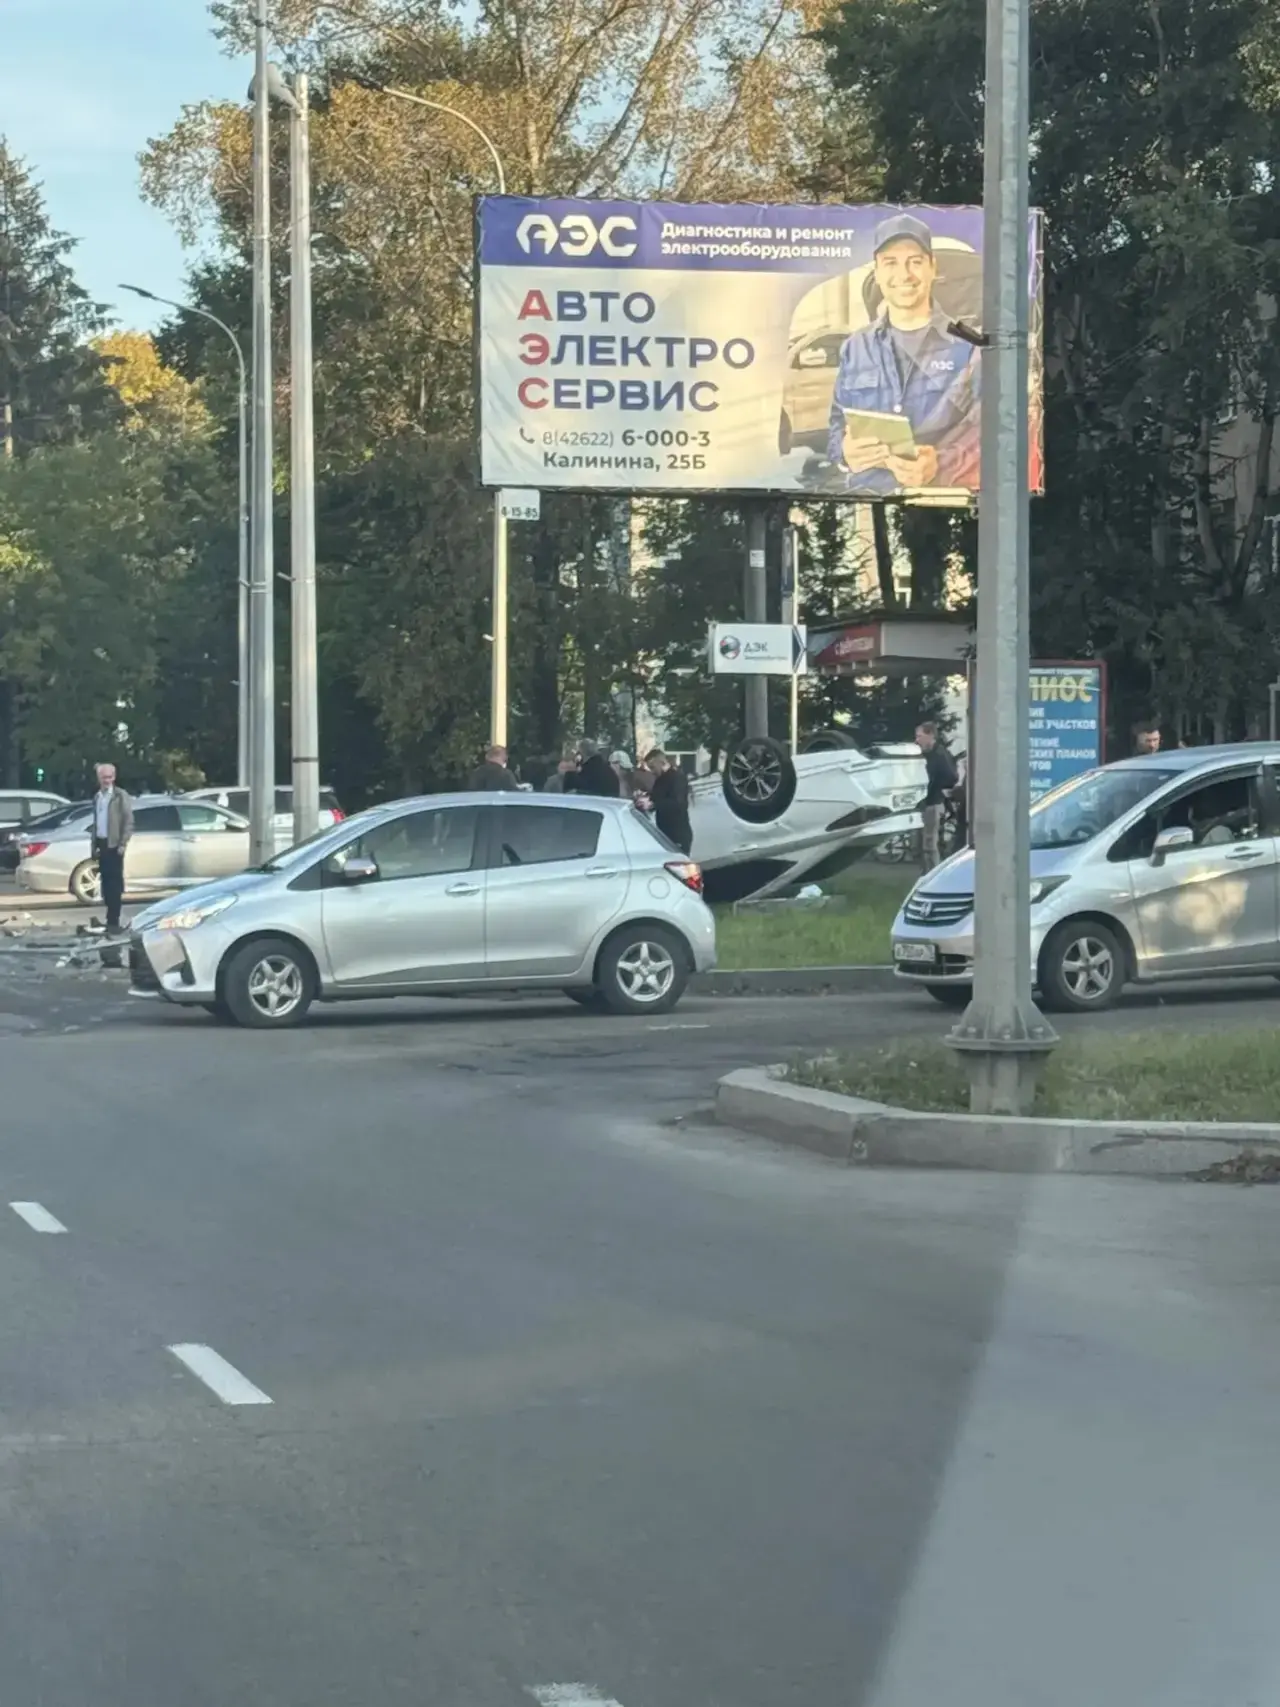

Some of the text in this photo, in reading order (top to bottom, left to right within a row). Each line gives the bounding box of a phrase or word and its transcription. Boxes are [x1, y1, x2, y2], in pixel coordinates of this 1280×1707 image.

[516, 213, 638, 257] АЭС
[661, 222, 854, 243] Диагностика и ремонт
[661, 241, 852, 260] электрооборудования
[517, 289, 656, 324] АВТО
[518, 333, 755, 369] ЭЛЕКТРО
[518, 377, 720, 412] СЕРВИС
[542, 429, 711, 449] 8(42622) 6-000-3
[543, 452, 706, 472] Калинина, 25Б
[1046, 719, 1097, 730] УЧАСТКОВ
[1056, 748, 1097, 760] ПЛАНОВ
